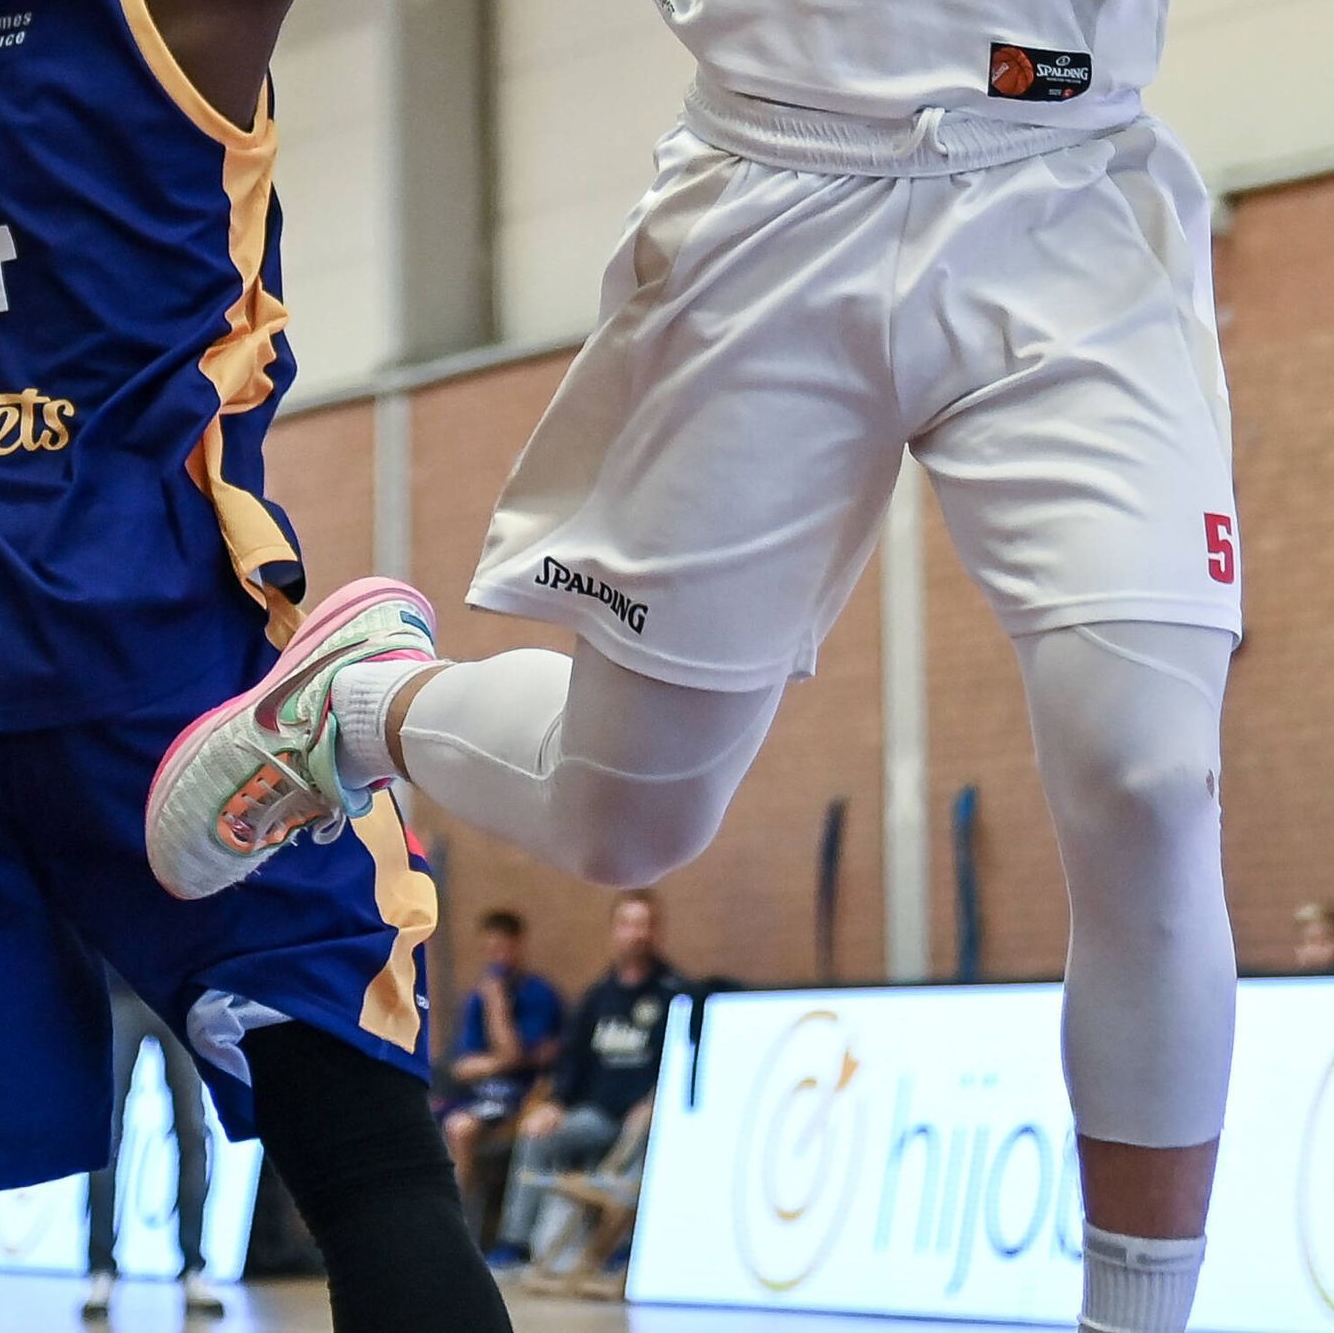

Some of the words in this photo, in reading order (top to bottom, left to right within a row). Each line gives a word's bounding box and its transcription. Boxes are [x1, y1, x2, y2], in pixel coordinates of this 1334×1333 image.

[1036, 63, 1089, 81] SPALDING
[1204, 513, 1234, 584] 5
[535, 555, 649, 635] SPALDING
